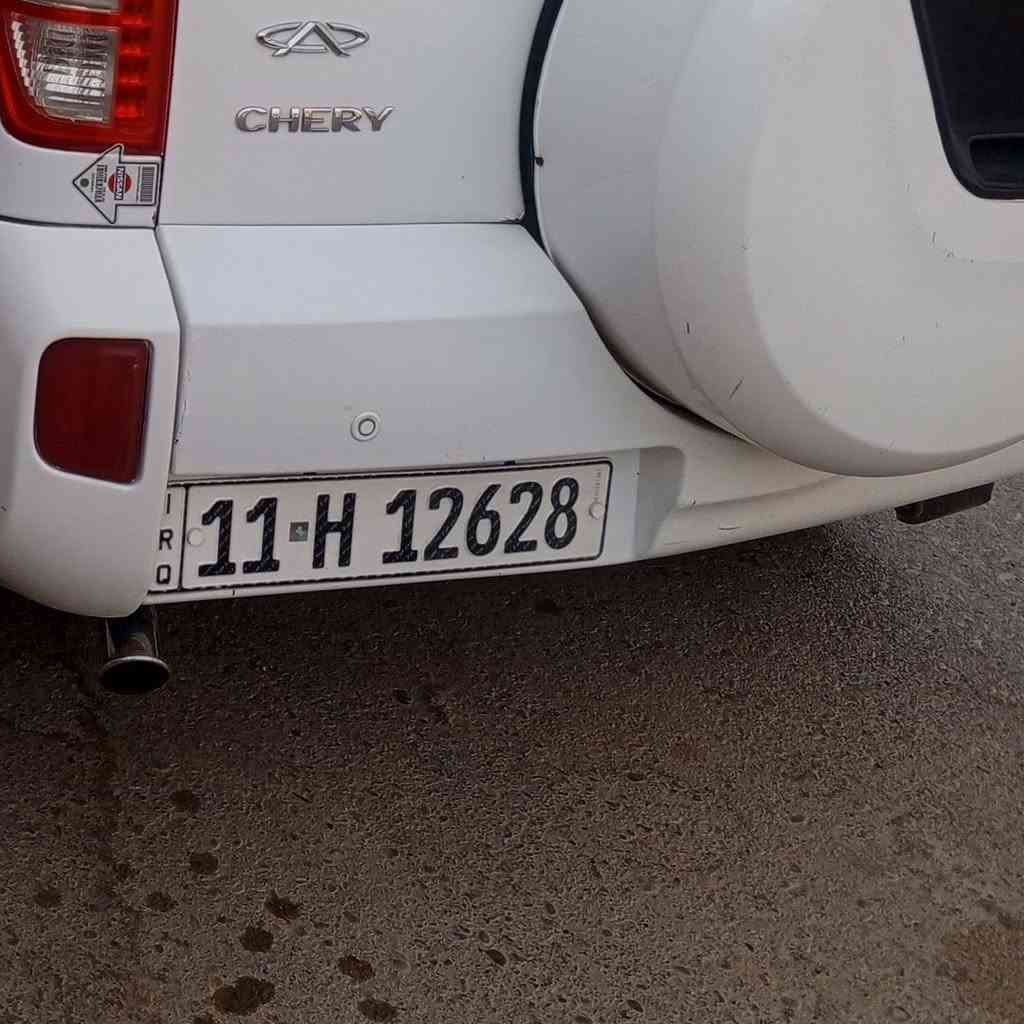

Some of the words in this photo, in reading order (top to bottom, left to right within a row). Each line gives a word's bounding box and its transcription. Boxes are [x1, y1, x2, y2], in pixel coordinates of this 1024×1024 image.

[235, 105, 393, 132] CHERY
[115, 166, 125, 200] NISSAN
[198, 497, 280, 577] 11
[312, 493, 357, 569] H
[382, 477, 580, 564] 12628
